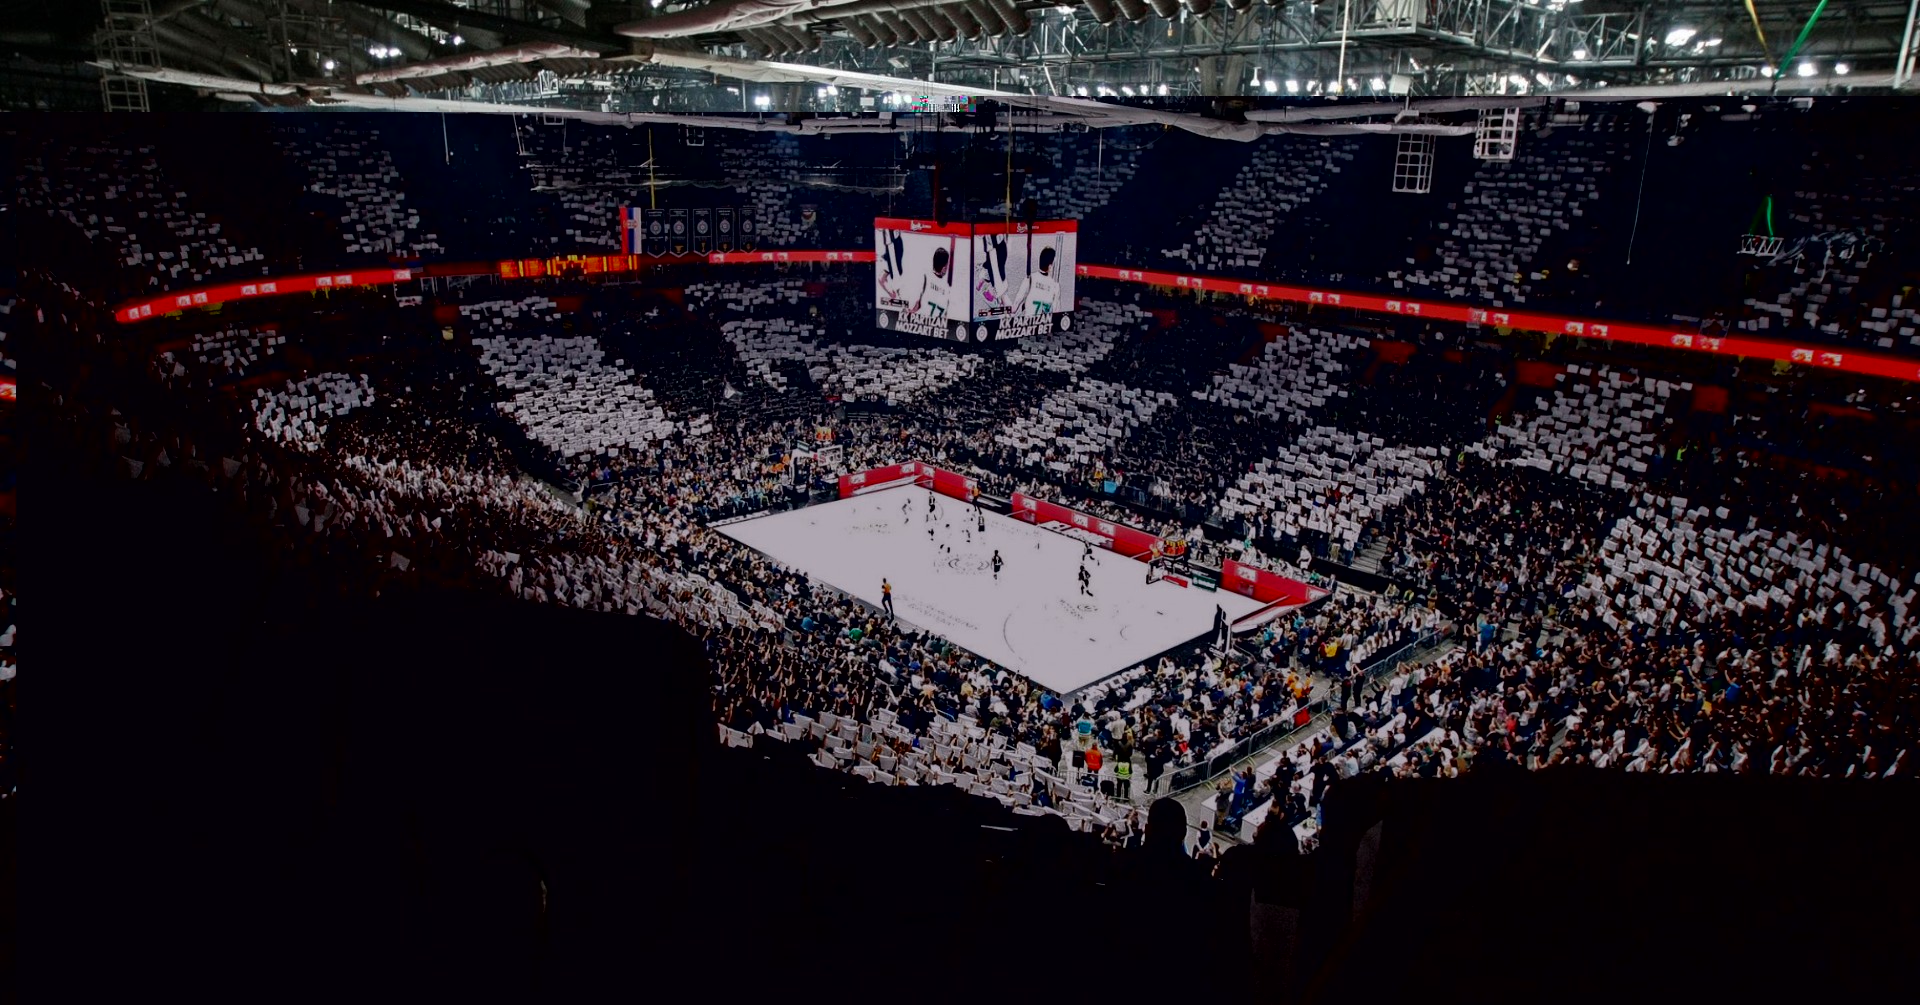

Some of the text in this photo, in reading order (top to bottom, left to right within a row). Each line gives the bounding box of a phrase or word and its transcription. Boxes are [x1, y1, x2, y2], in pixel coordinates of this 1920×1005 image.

[898, 311, 948, 328] KK PARTIZAN
[999, 313, 1053, 330] KK PARTIZAN
[895, 320, 949, 339] MOZZART BET
[995, 323, 1053, 340] MOZZART BET
